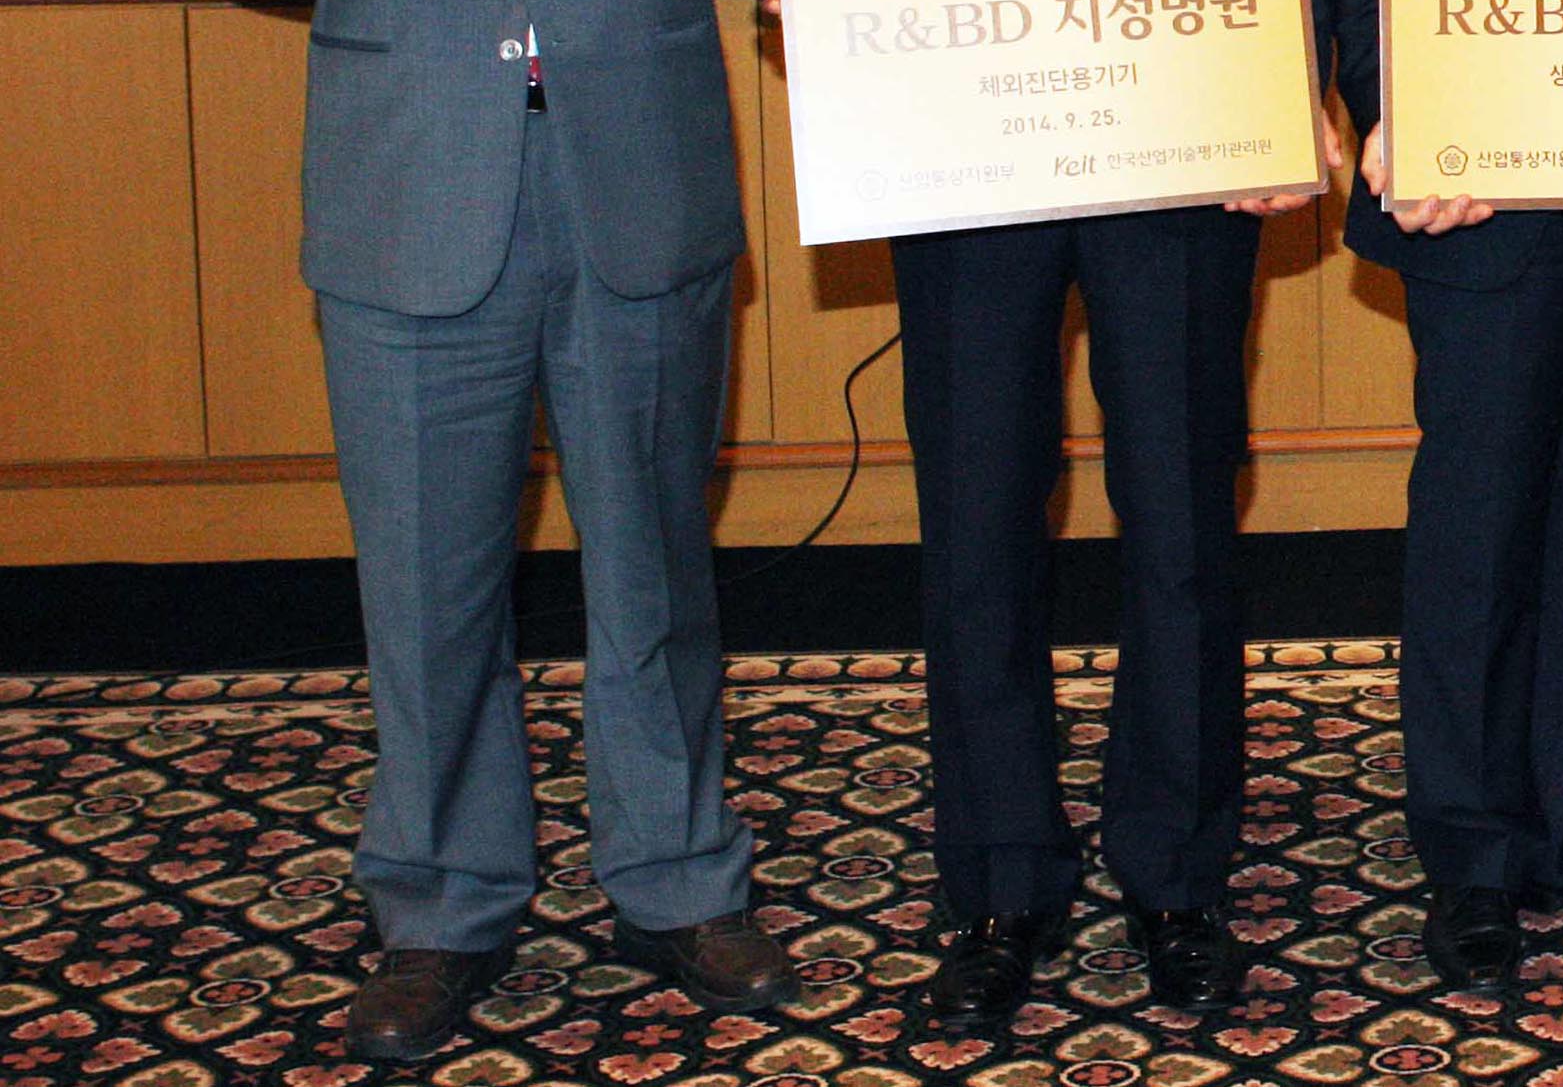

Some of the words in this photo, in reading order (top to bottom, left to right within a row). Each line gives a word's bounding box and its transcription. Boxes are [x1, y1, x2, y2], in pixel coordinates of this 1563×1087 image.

[844, 0, 1033, 58] R&BD
[978, 62, 1139, 98] 체외진단용기기
[1001, 114, 1057, 136] 2014.
[1092, 108, 1121, 128] 25.
[1053, 154, 1098, 177] Keit
[1106, 138, 1273, 170] 한국산업기술평가관리원
